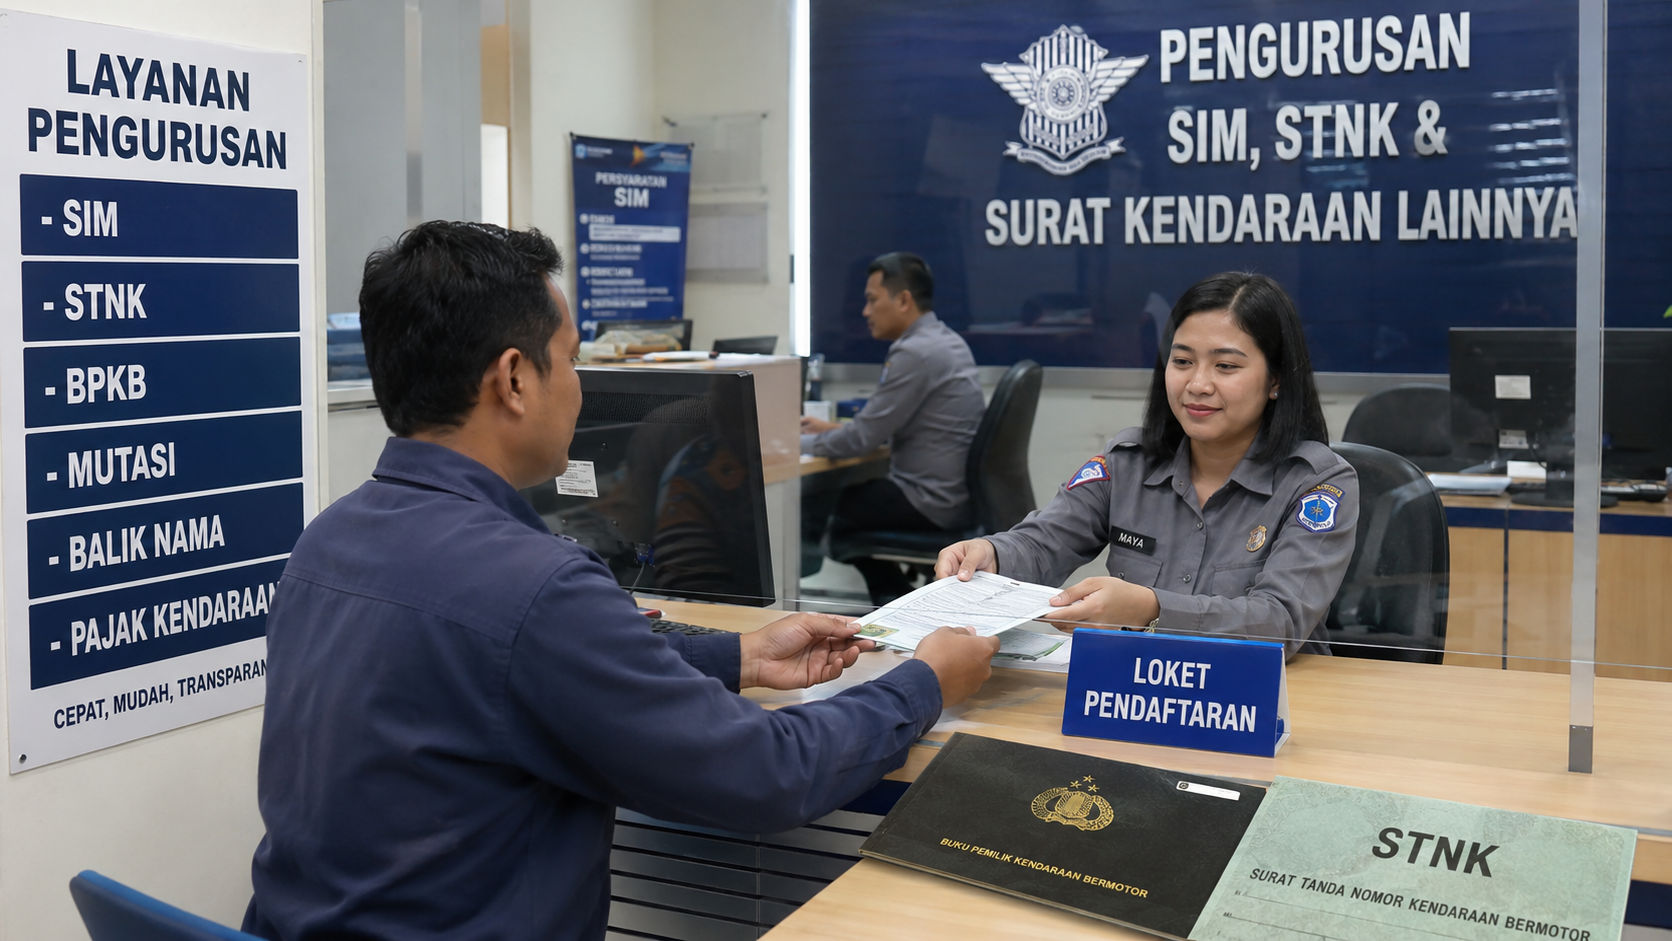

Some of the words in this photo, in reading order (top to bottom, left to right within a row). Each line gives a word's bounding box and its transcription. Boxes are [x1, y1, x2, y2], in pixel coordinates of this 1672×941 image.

[1160, 11, 1470, 83] PENGURUSAN
[67, 48, 250, 112] LAYANAN
[28, 107, 286, 170] PENGURUSAN
[1167, 107, 1260, 171] SIM,
[1275, 102, 1399, 160] STNK
[1413, 99, 1448, 155] &
[63, 199, 118, 237] SIM
[614, 187, 649, 208] SIM
[985, 197, 1111, 245] SURAT
[1125, 191, 1381, 244] KENDARAAN
[1398, 186, 1578, 240] LAINNYA
[64, 283, 147, 321] STNK
[66, 364, 147, 404] BPKB
[68, 442, 176, 488] MUTASI
[69, 525, 147, 572] BALIK
[154, 514, 225, 557] NAMA
[1118, 532, 1144, 548] MAYA
[71, 607, 147, 656] PAJAK
[1133, 657, 1211, 689] LOKET
[54, 699, 109, 729] CEPAT,
[113, 683, 173, 714] MUDAH,
[1084, 690, 1257, 732] PENDAFTARAN
[940, 837, 970, 851] BUKU
[971, 845, 1013, 863] PEMILIK
[1013, 856, 1082, 881] KENDARAAN
[1083, 874, 1149, 898] BERMOTOR
[1372, 827, 1499, 878] STNK
[1250, 868, 1296, 886] SURAT
[1300, 877, 1345, 896] TANDA
[1350, 887, 1404, 908] NOMOR
[1408, 898, 1500, 926] KENDARAAN
[1504, 915, 1591, 941] BERMOTOR
